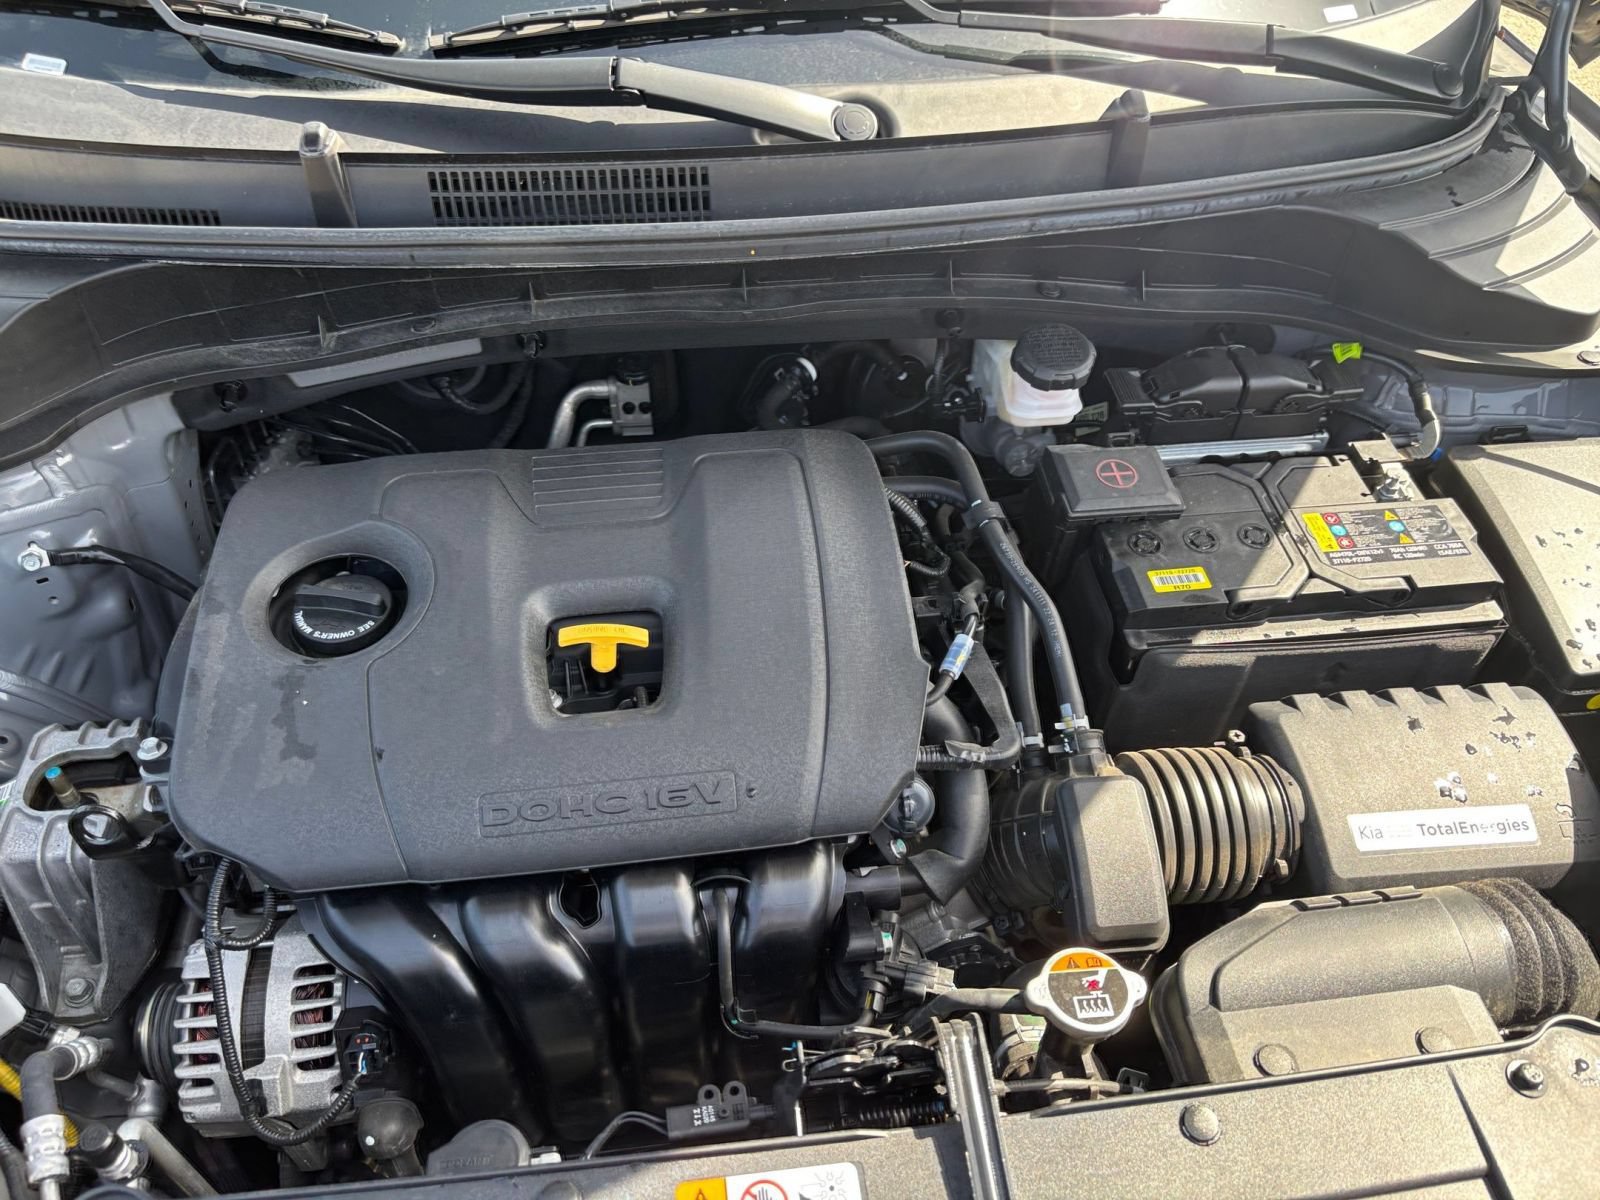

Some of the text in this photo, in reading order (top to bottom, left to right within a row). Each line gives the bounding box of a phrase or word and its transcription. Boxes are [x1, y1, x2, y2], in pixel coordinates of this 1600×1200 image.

[294, 610, 375, 640] SEE OWNER'S MANUAL
[482, 781, 722, 827] DOHC 16V
[1358, 825, 1384, 840] Kia
